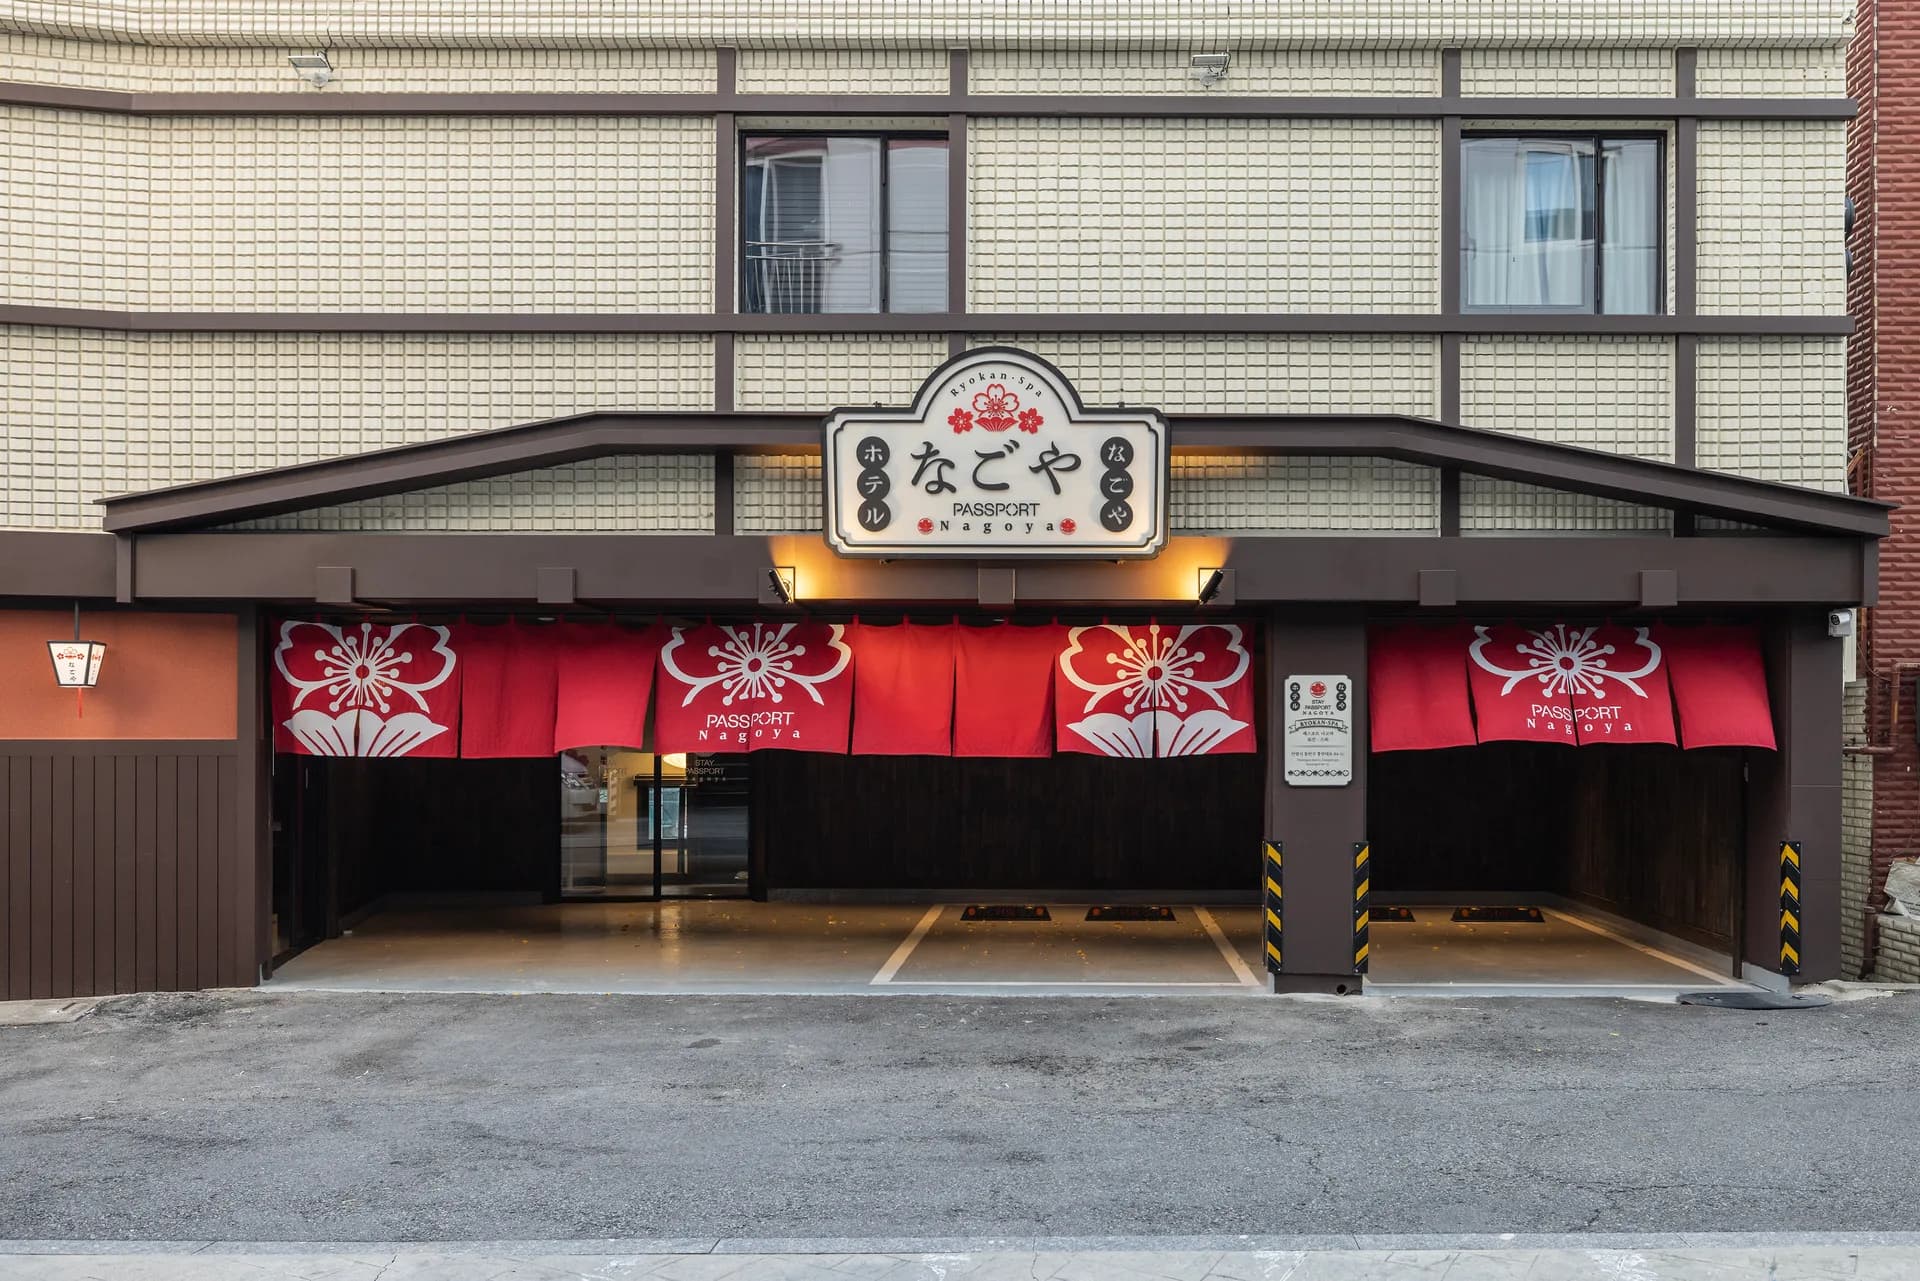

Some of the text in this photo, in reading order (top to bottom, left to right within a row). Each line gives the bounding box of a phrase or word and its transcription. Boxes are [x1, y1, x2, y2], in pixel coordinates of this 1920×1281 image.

[910, 439, 1082, 495] なごや
[863, 444, 884, 524] ホテル
[1107, 444, 1129, 525] なごや
[953, 502, 1041, 517] PASSPORT
[940, 520, 1054, 534] Nagoya
[707, 712, 795, 728] PASSPORT
[1531, 704, 1622, 722] PASSPORT
[1527, 718, 1633, 734] Nagoya
[699, 728, 801, 743] Nagoya
